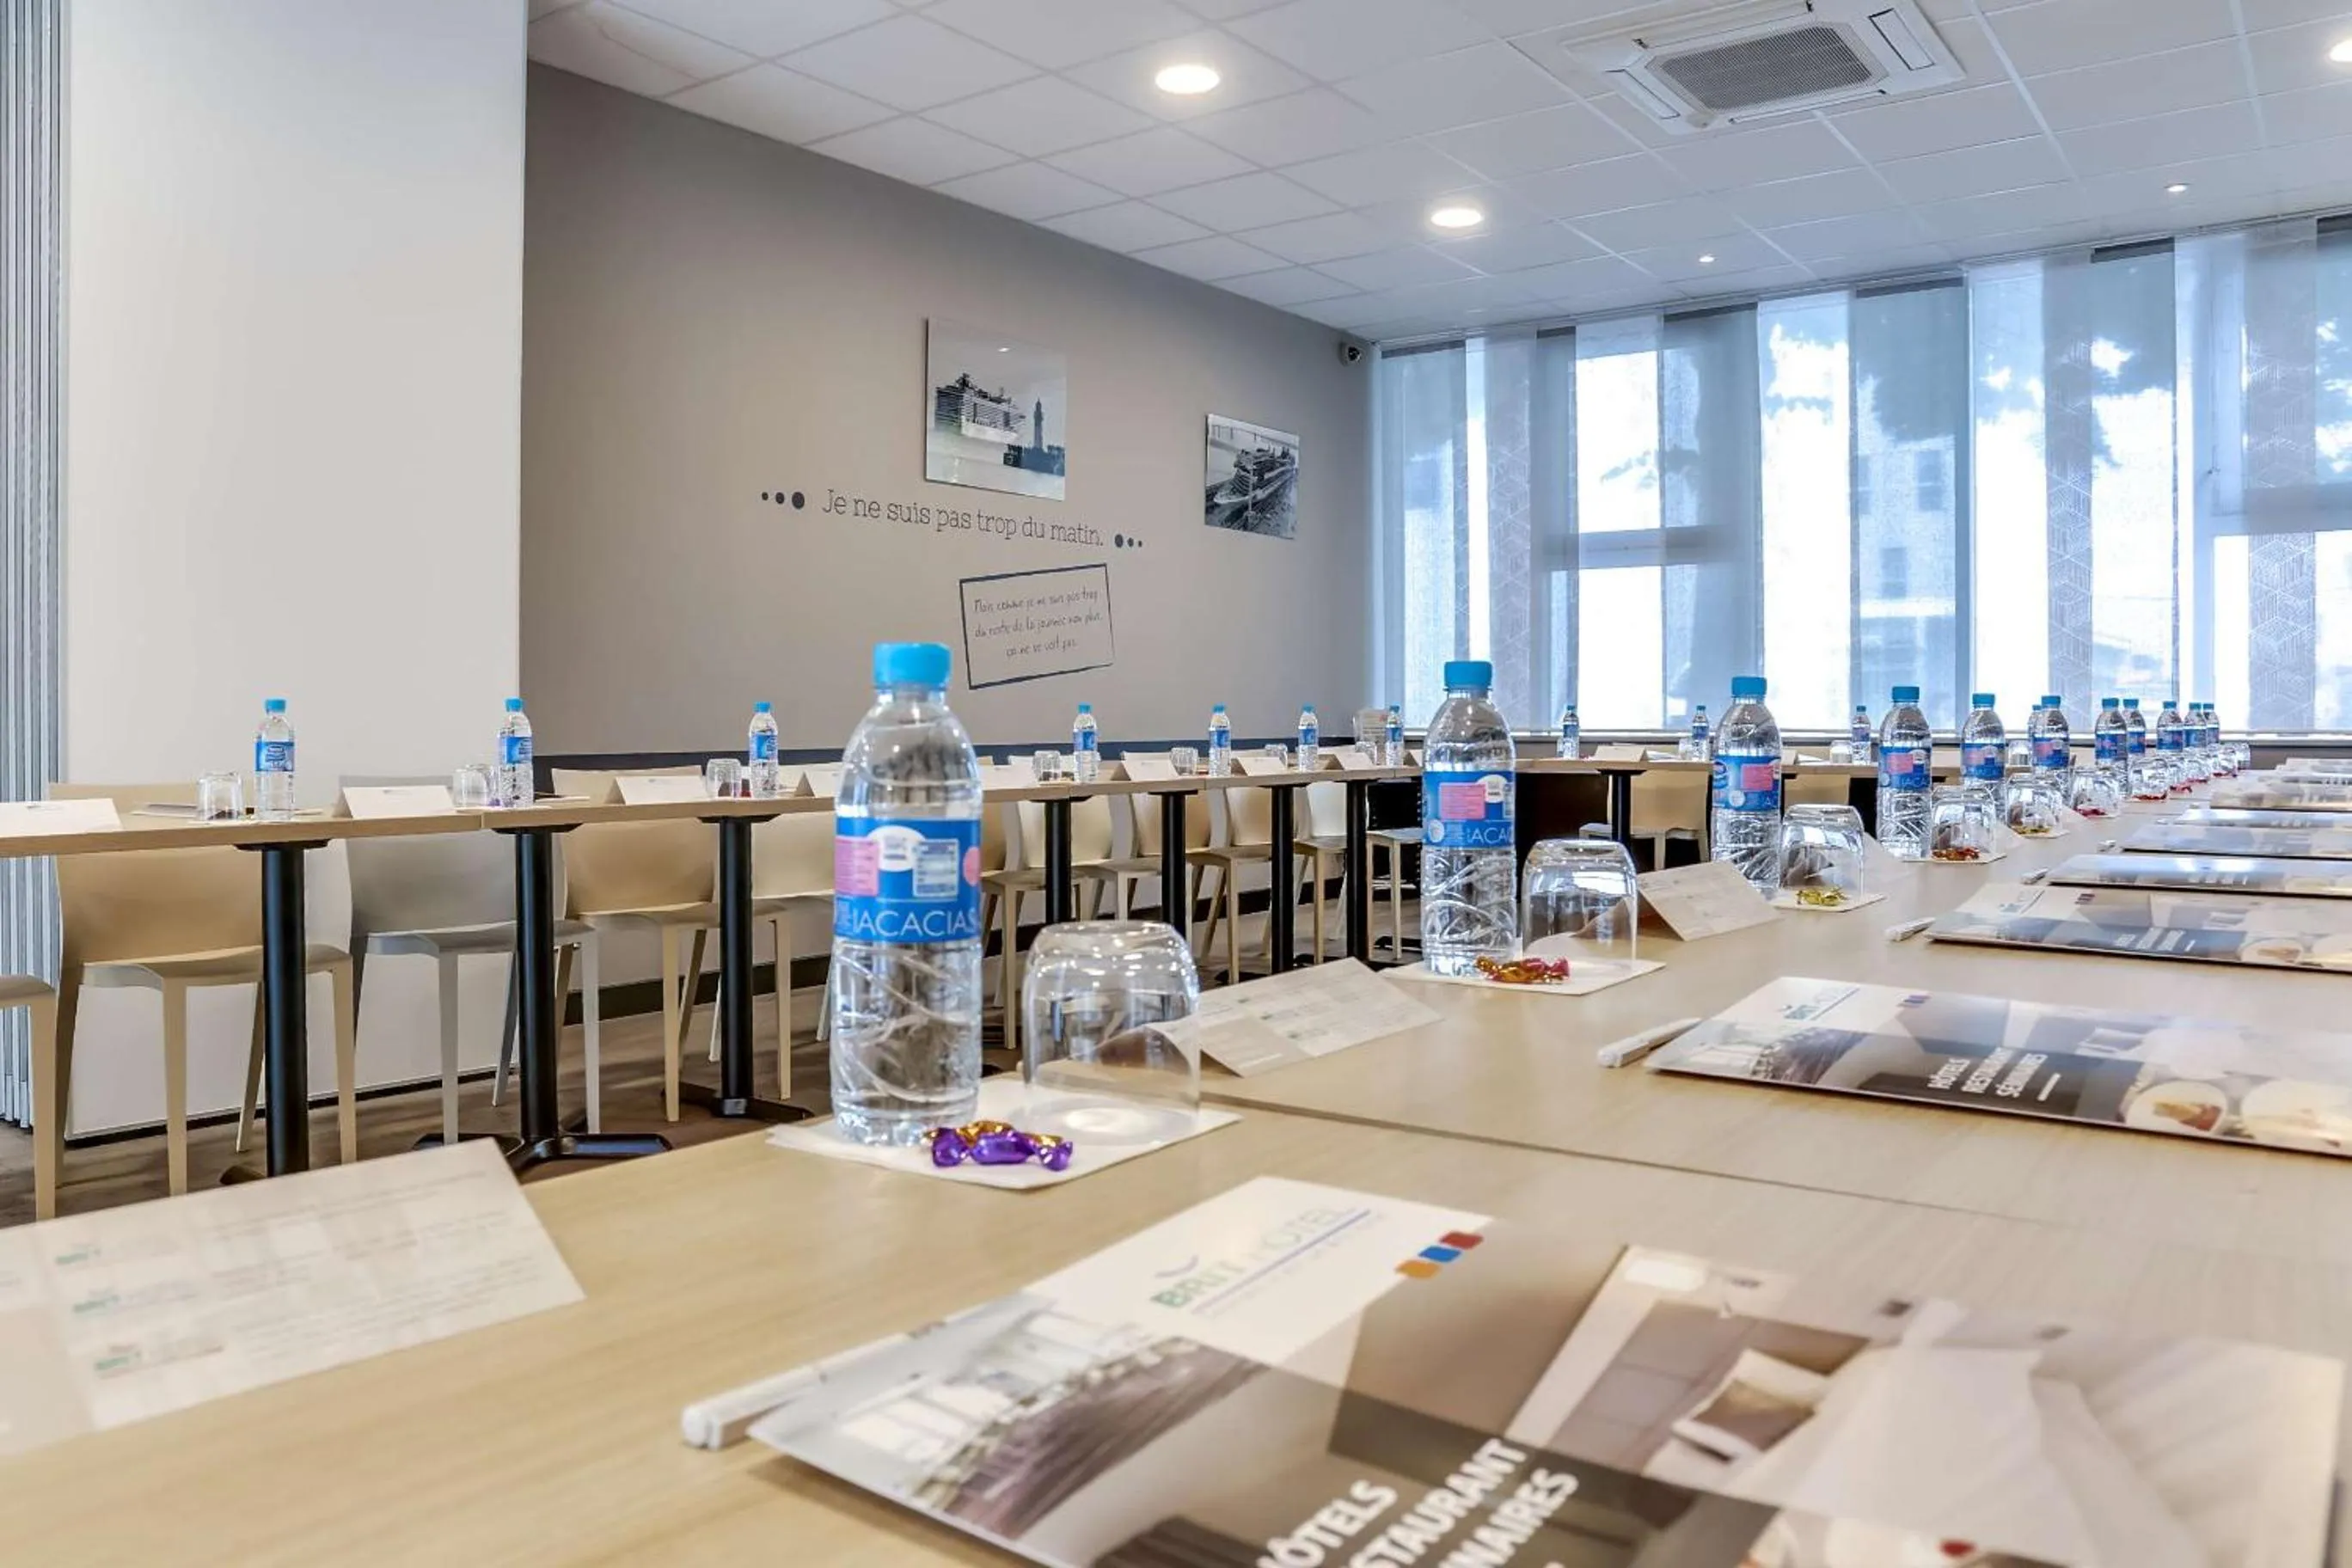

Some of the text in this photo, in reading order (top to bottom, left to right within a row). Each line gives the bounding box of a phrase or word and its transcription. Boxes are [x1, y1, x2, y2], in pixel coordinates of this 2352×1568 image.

[822, 488, 1104, 546] Je ne suis pas trop du matin.
[1256, 1479, 1399, 1568] ÔTELS
[1343, 1437, 1527, 1568] STAURANT
